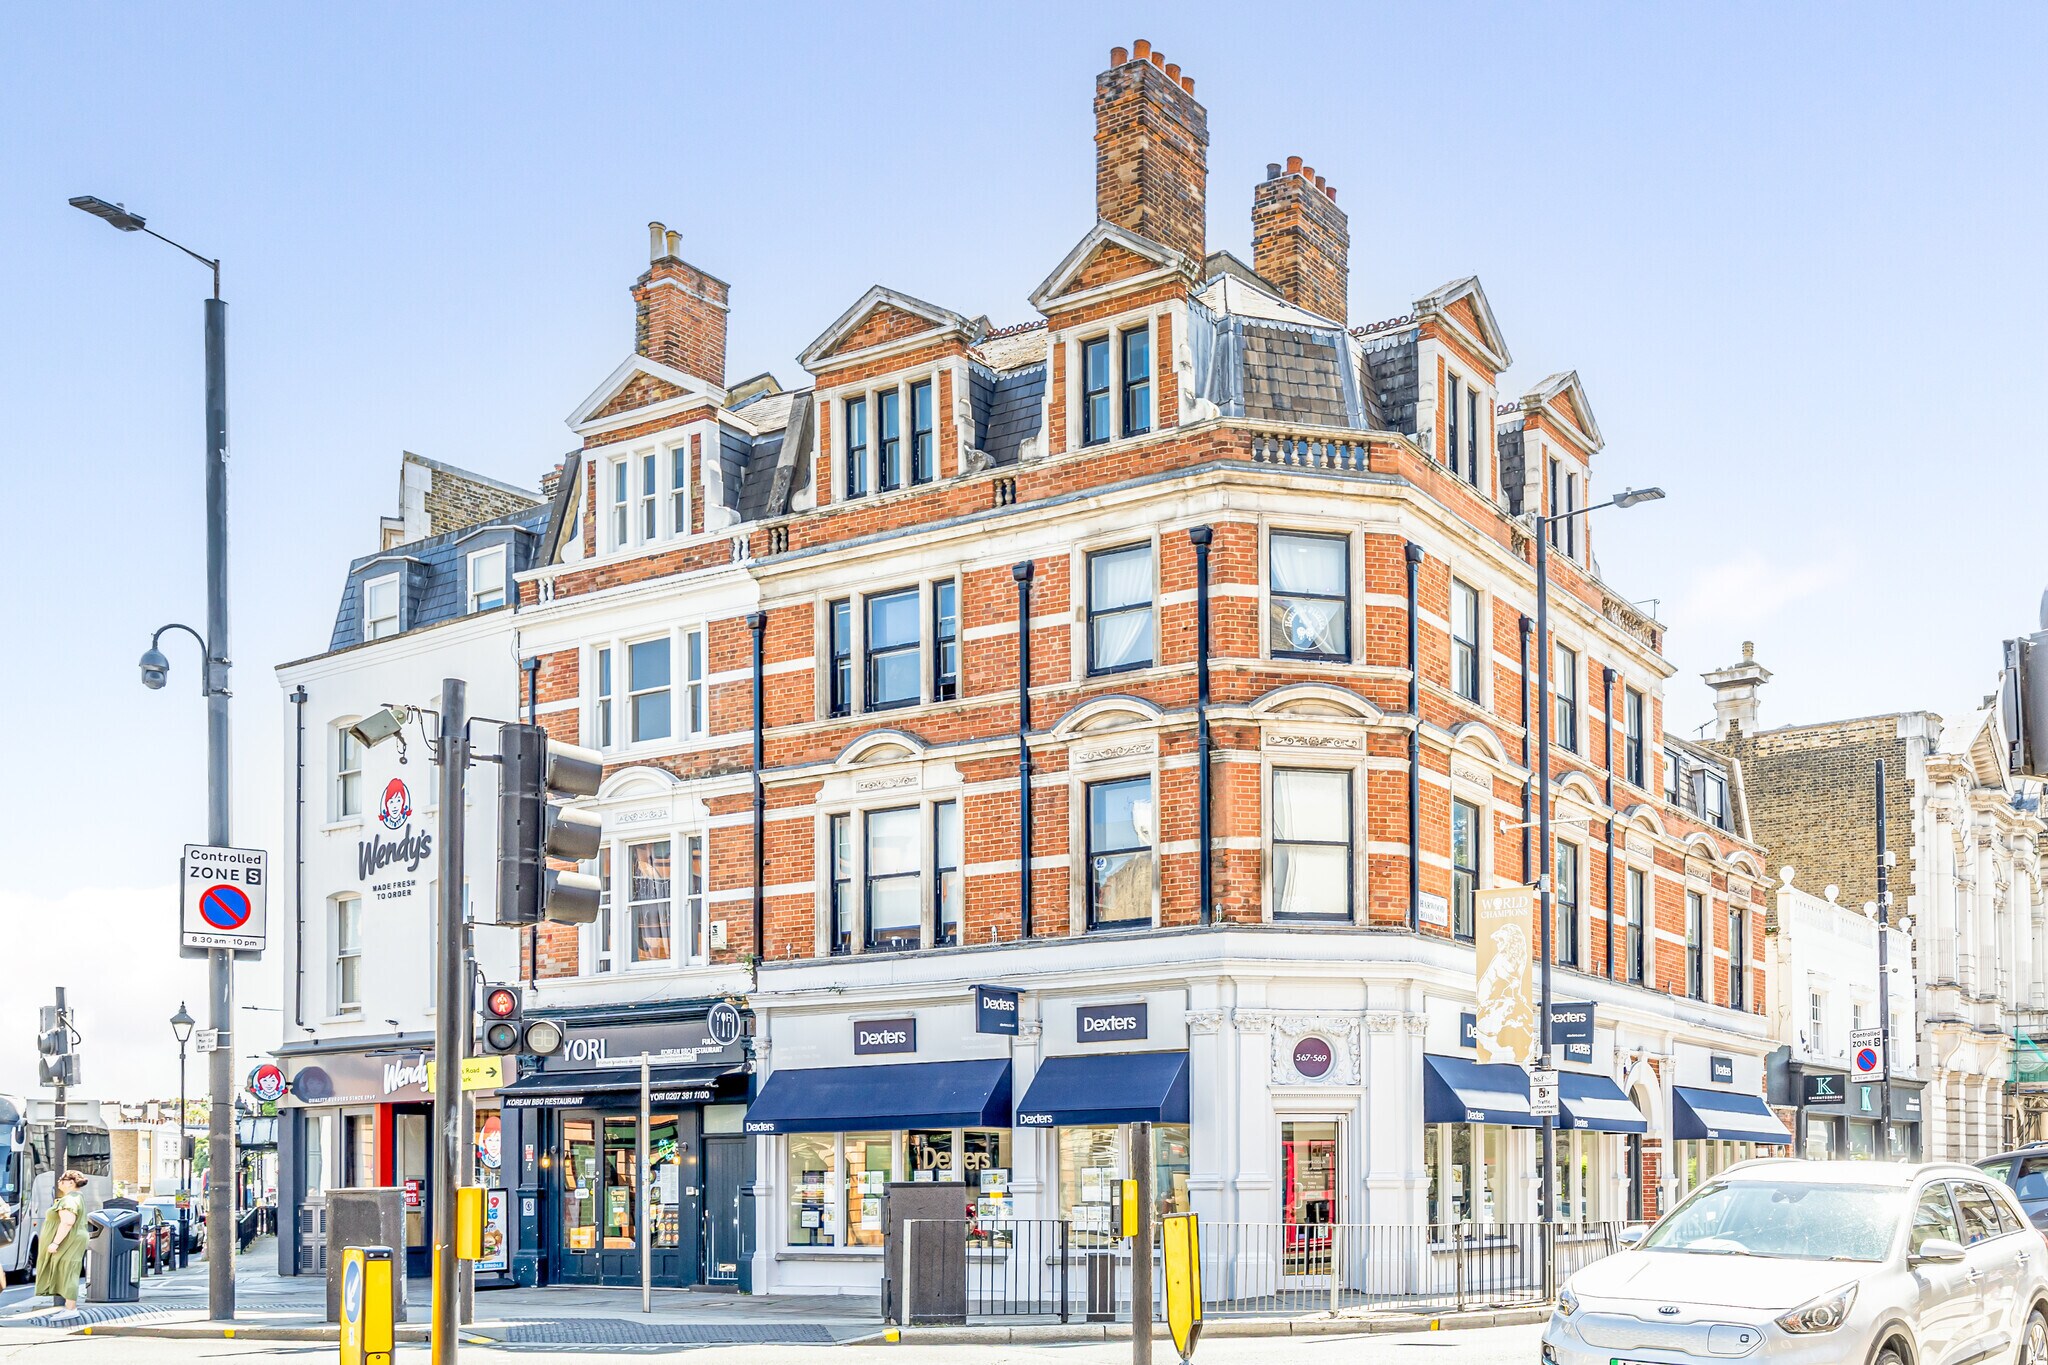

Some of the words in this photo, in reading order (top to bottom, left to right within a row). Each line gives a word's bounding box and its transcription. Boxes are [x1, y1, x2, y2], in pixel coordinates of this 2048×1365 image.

[190, 849, 261, 864] Controlled
[358, 823, 432, 881] Wendy's
[190, 866, 240, 881] ZONE
[248, 869, 260, 883] S
[372, 883, 391, 892] MADE
[393, 880, 416, 889] FRESH
[387, 889, 412, 898] ORDER
[1482, 896, 1528, 910] WORLD
[1481, 908, 1528, 919] CHAMPIONS
[983, 997, 1015, 1011] Dexters
[1083, 1015, 1137, 1032] Dexters
[860, 1029, 907, 1046] Dexters
[1852, 1031, 1881, 1039] Controlled
[1852, 1039, 1872, 1047] ZONE
[564, 1038, 606, 1062] YORI
[691, 1046, 724, 1055] RESTAURANT
[1295, 1053, 1328, 1062] 567-569
[383, 1054, 429, 1095] Wendy
[1715, 1064, 1732, 1076] Dexters
[1816, 1077, 1835, 1095] K
[506, 1098, 532, 1106] KOREAN
[532, 1098, 544, 1106] BBQ
[544, 1097, 584, 1106] RESTAURANT
[650, 1093, 666, 1101] YORI
[666, 1092, 681, 1100] 0207
[681, 1091, 693, 1100] 381
[694, 1090, 710, 1099] 1100
[1860, 1086, 1872, 1111] K
[1020, 1114, 1053, 1124] Dexters
[1467, 1110, 1485, 1121] Dexters
[746, 1122, 775, 1132] Dexters
[1574, 1118, 1589, 1128] Dexters
[923, 1147, 991, 1170] Deers
